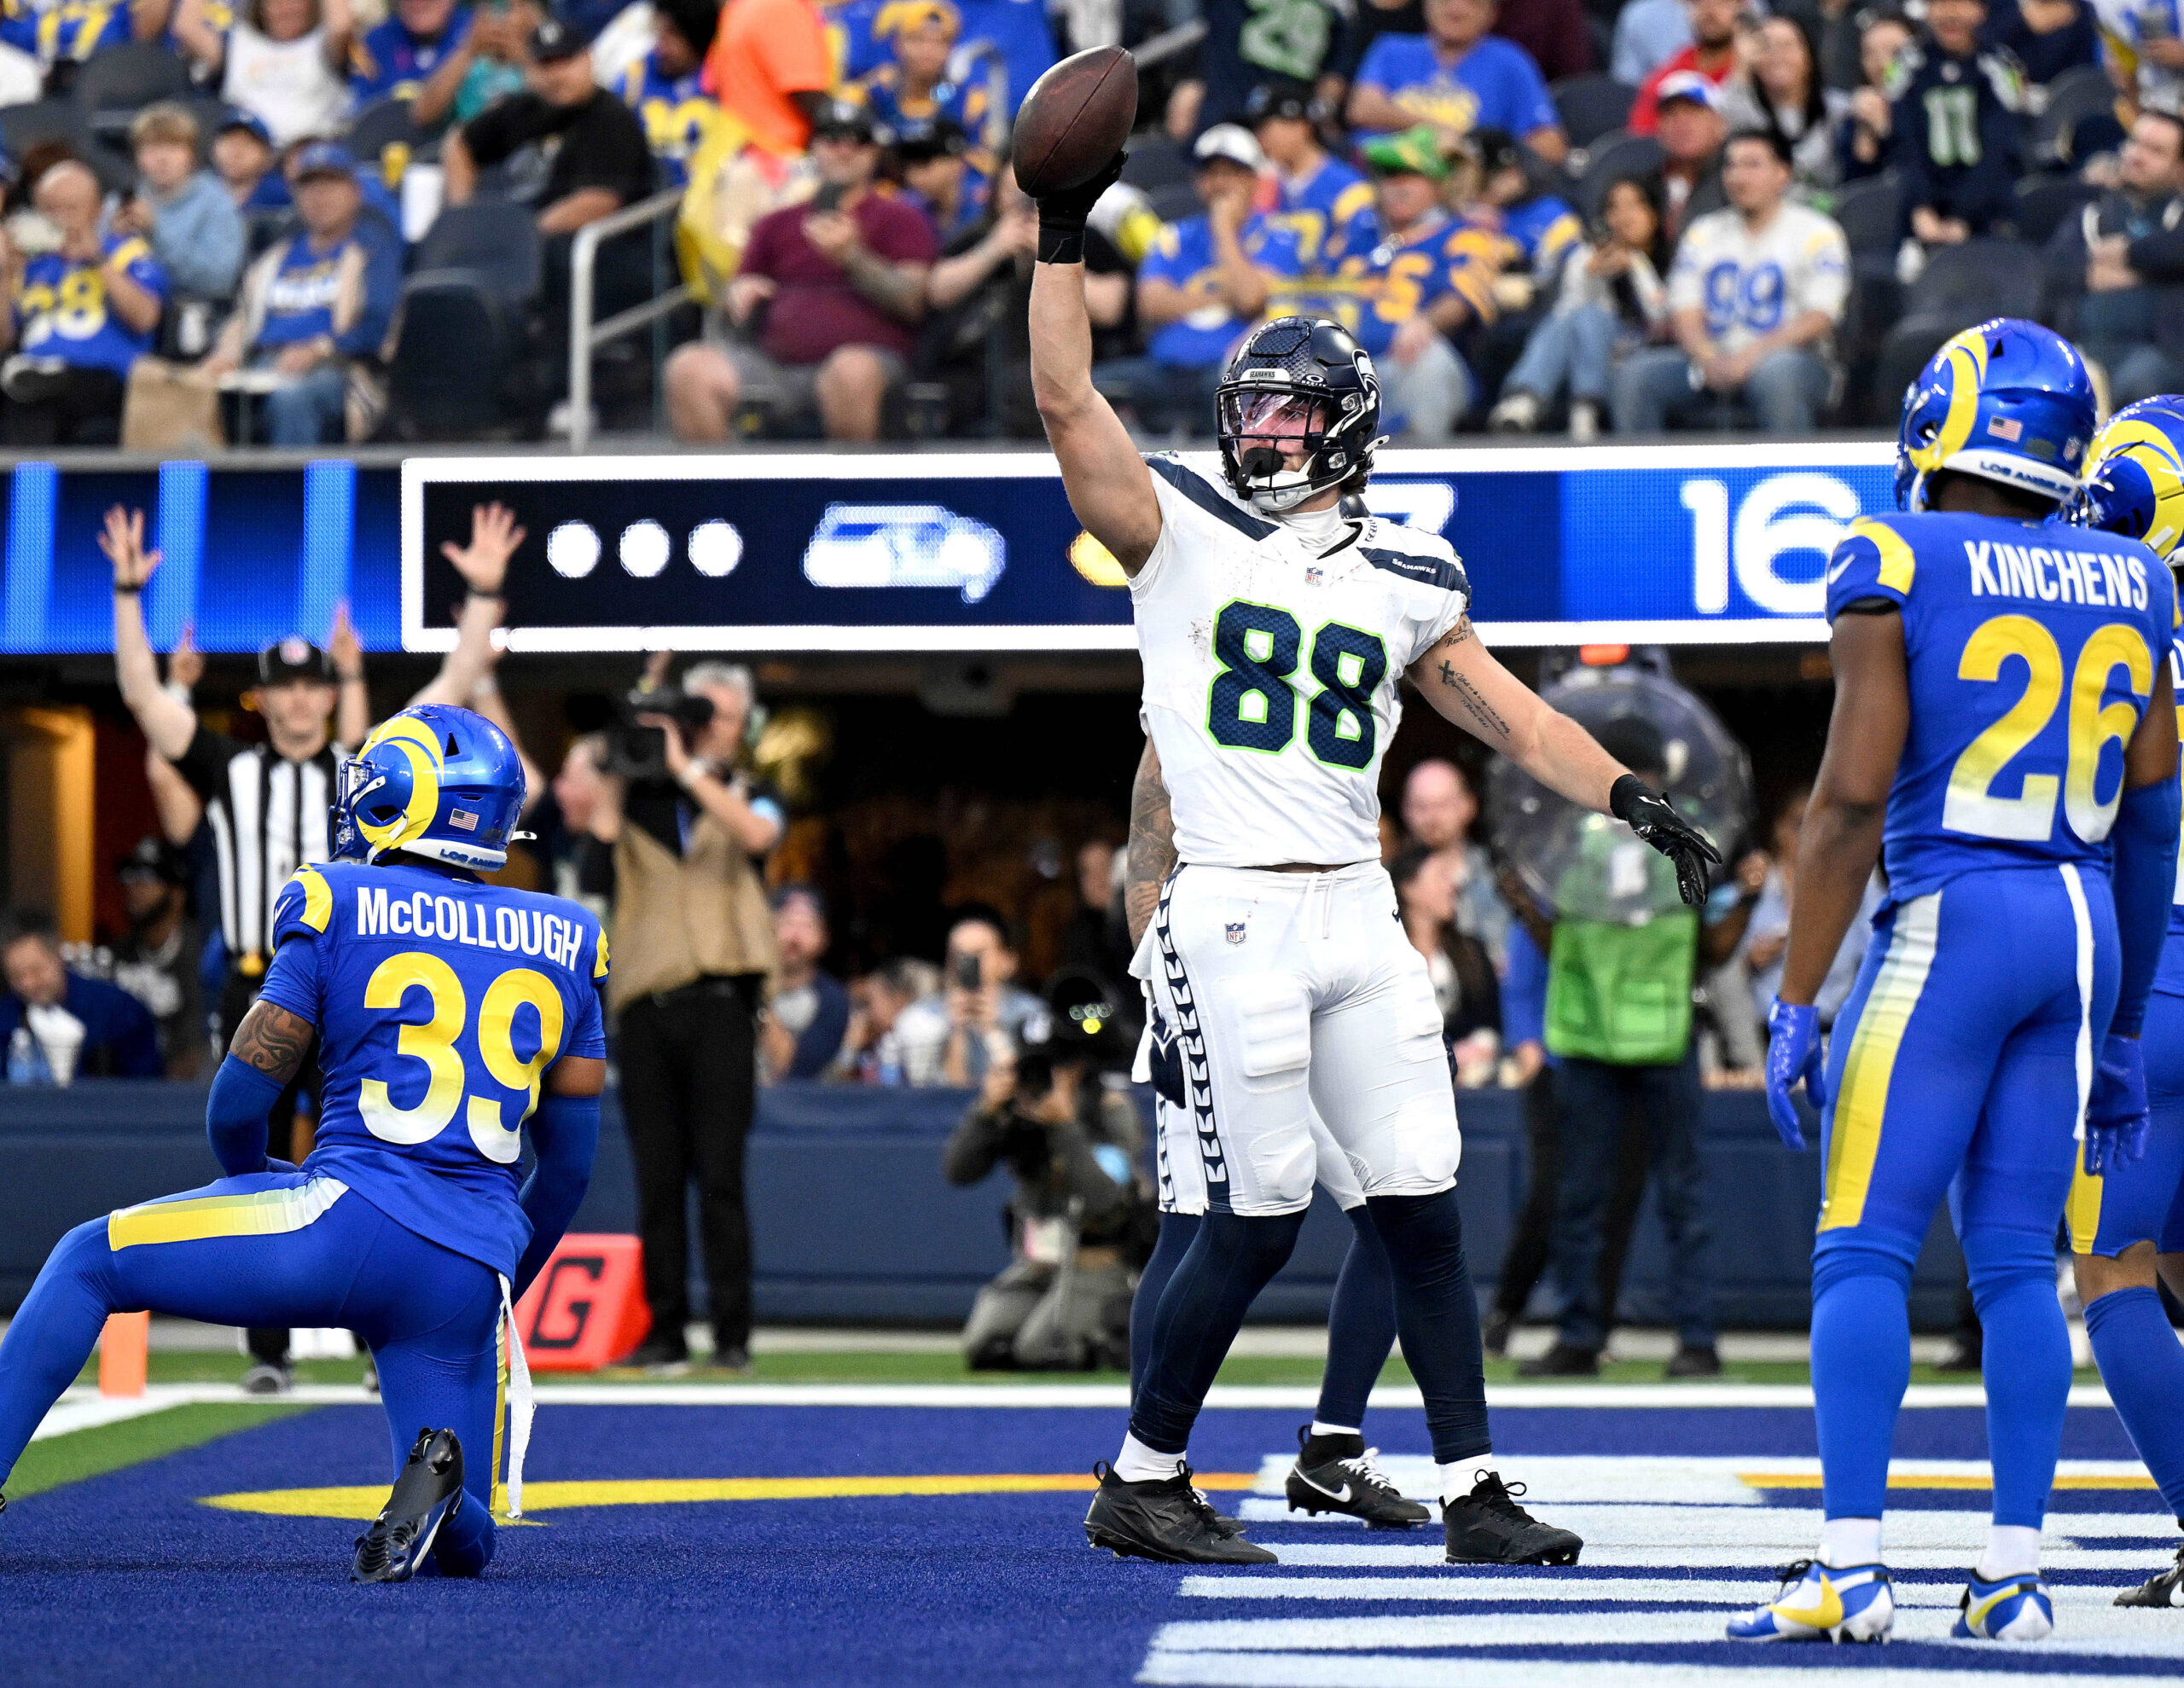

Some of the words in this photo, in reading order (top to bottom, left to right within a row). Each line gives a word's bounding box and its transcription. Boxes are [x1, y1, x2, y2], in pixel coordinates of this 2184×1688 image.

[1923, 87, 1983, 166] 11
[1704, 260, 1786, 335] 99
[1680, 473, 1861, 613] 16
[1963, 540, 2148, 612] KINCHENS
[1205, 597, 1389, 773] 88
[1942, 614, 2152, 843] 26
[440, 849, 469, 863] LOS
[357, 887, 583, 972] McCOLLOUGH
[358, 952, 563, 1163] 39
[529, 1257, 605, 1349] G
